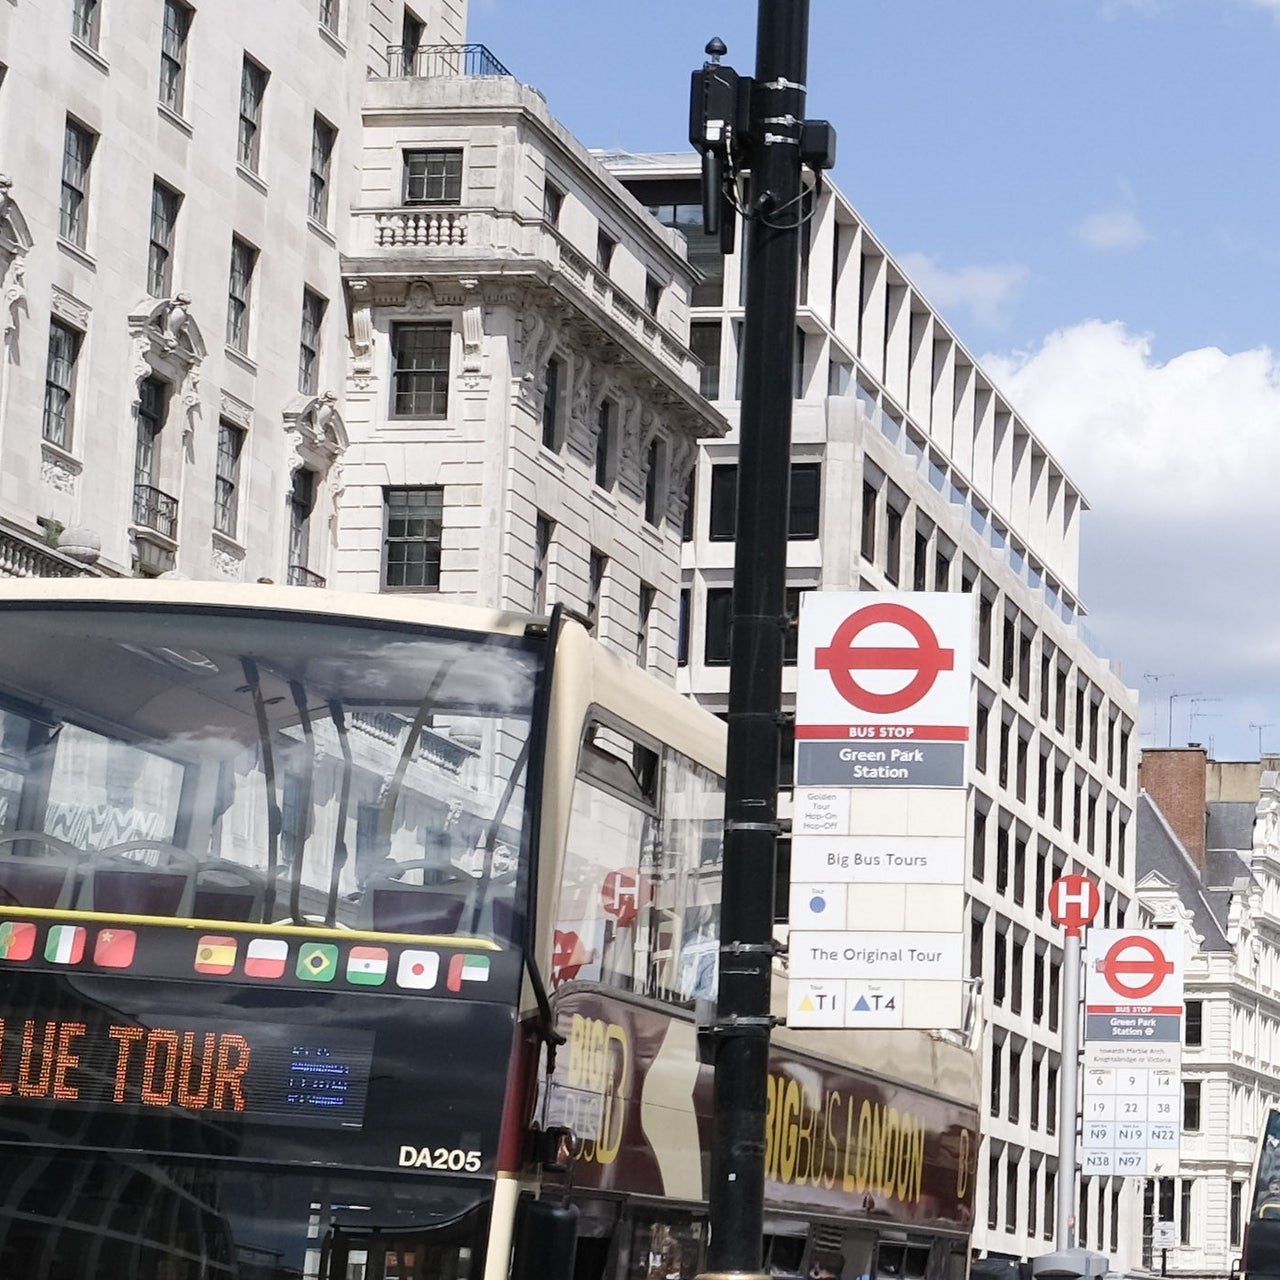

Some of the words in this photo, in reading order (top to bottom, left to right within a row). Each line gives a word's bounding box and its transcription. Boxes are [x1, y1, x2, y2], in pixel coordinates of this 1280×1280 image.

[848, 727, 874, 738] BUS
[879, 727, 914, 738] STOP
[839, 748, 885, 762] Green
[891, 749, 923, 762] Park
[853, 765, 908, 779] Station
[807, 793, 837, 801] Golden
[813, 803, 830, 811] Tour
[827, 853, 849, 868] Big
[854, 854, 880, 866] Bus
[886, 854, 927, 867] Tours
[1058, 881, 1090, 919] H
[811, 949, 838, 961] The
[844, 949, 903, 963] Original
[908, 950, 942, 962] Tour
[816, 995, 836, 1010] T1
[871, 995, 896, 1010] T4
[1110, 1018, 1136, 1026] Green
[1137, 1018, 1156, 1026] Park
[1112, 1027, 1142, 1036] Station
[109, 1024, 252, 1111] TOUR
[1096, 1076, 1103, 1085] 6
[1129, 1076, 1135, 1085] 9
[1158, 1077, 1170, 1085] 14
[1093, 1103, 1105, 1112] 19
[1125, 1103, 1138, 1112] 22
[1157, 1104, 1170, 1113] 38
[1090, 1130, 1106, 1139] N9
[1119, 1130, 1142, 1139] N19
[1151, 1130, 1174, 1140] N22
[842, 1095, 925, 1204] LONDON
[399, 1145, 482, 1172] DA205
[1087, 1157, 1109, 1166] N38
[1119, 1157, 1142, 1166] N97
